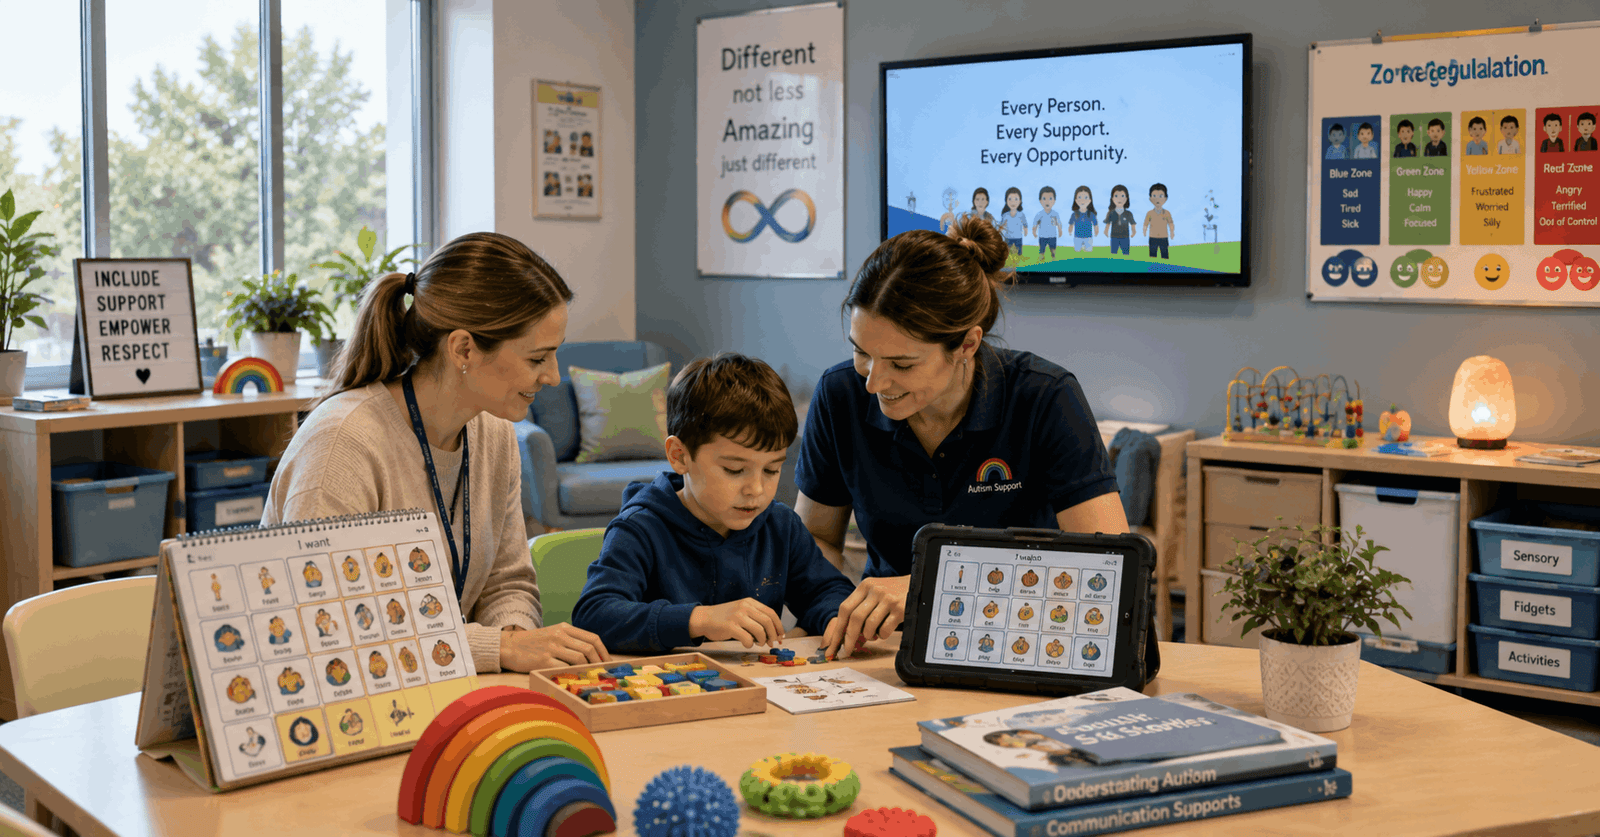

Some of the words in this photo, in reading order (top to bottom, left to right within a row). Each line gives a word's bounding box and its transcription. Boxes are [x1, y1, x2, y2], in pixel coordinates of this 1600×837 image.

[721, 42, 815, 71] Different
[733, 85, 762, 103] not
[769, 80, 803, 102] less
[1001, 100, 1043, 118] Every
[1048, 97, 1105, 113] Person.
[722, 117, 814, 145] Amazing
[996, 124, 1038, 142] Every
[1043, 121, 1109, 141] Support.
[981, 149, 1022, 167] Every
[1026, 144, 1128, 166] Opportunity.
[720, 154, 747, 178] just
[752, 153, 817, 173] different
[1329, 168, 1349, 178] Blue
[1351, 168, 1373, 178] Zone
[1396, 166, 1421, 176] Green
[1423, 165, 1445, 176] Zone
[1407, 188, 1433, 198] Happy
[1471, 186, 1514, 196] Frustrated
[1556, 185, 1583, 197] Angry
[1340, 204, 1361, 213] Tired
[1551, 200, 1587, 211] Terrified
[1341, 219, 1359, 228] Sick
[1567, 216, 1598, 226] Control
[95, 270, 160, 287] INCLUDE
[97, 294, 166, 312] SUPPORT
[99, 318, 171, 336] EMPOWER
[101, 342, 170, 362] RESPECT
[967, 484, 992, 493] Autism
[994, 481, 1022, 493] Support
[298, 540, 302, 550] I
[305, 538, 331, 549] want
[1513, 550, 1559, 567] Sensory
[1514, 600, 1556, 616] Fidgets
[1508, 650, 1560, 668] Activities
[1046, 805, 1170, 837] Communication
[1173, 794, 1242, 818] Supports
